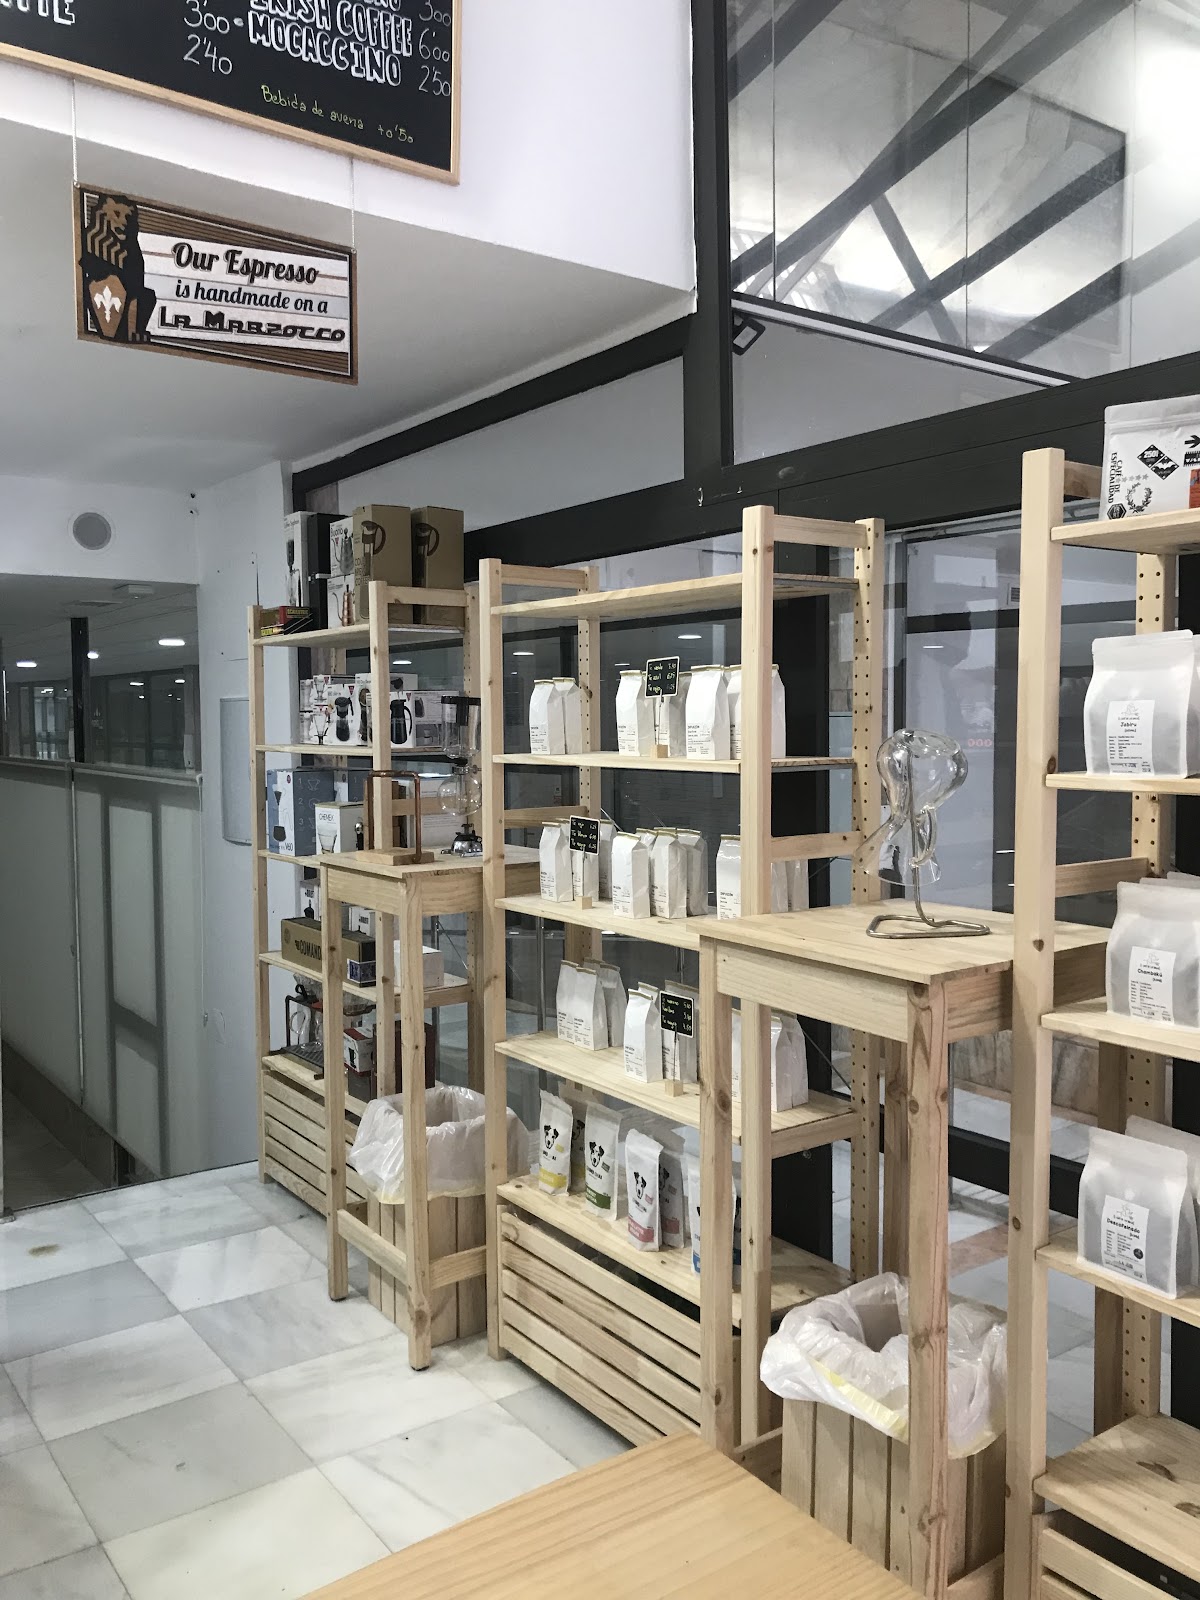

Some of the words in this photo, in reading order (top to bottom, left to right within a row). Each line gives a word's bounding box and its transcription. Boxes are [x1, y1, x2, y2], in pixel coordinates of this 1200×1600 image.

[248, 10, 401, 86] MOCACCINO
[336, 0, 412, 57] COFFEE
[261, 85, 307, 112] Bebida
[312, 100, 325, 118] de
[330, 111, 364, 130] avena
[172, 241, 219, 272] Our
[223, 249, 319, 286] Espresso
[175, 279, 191, 299] is
[194, 282, 290, 309] handmade
[294, 299, 313, 313] on
[317, 300, 328, 314] a
[1108, 452, 1118, 504] ESPECIALIDAD
